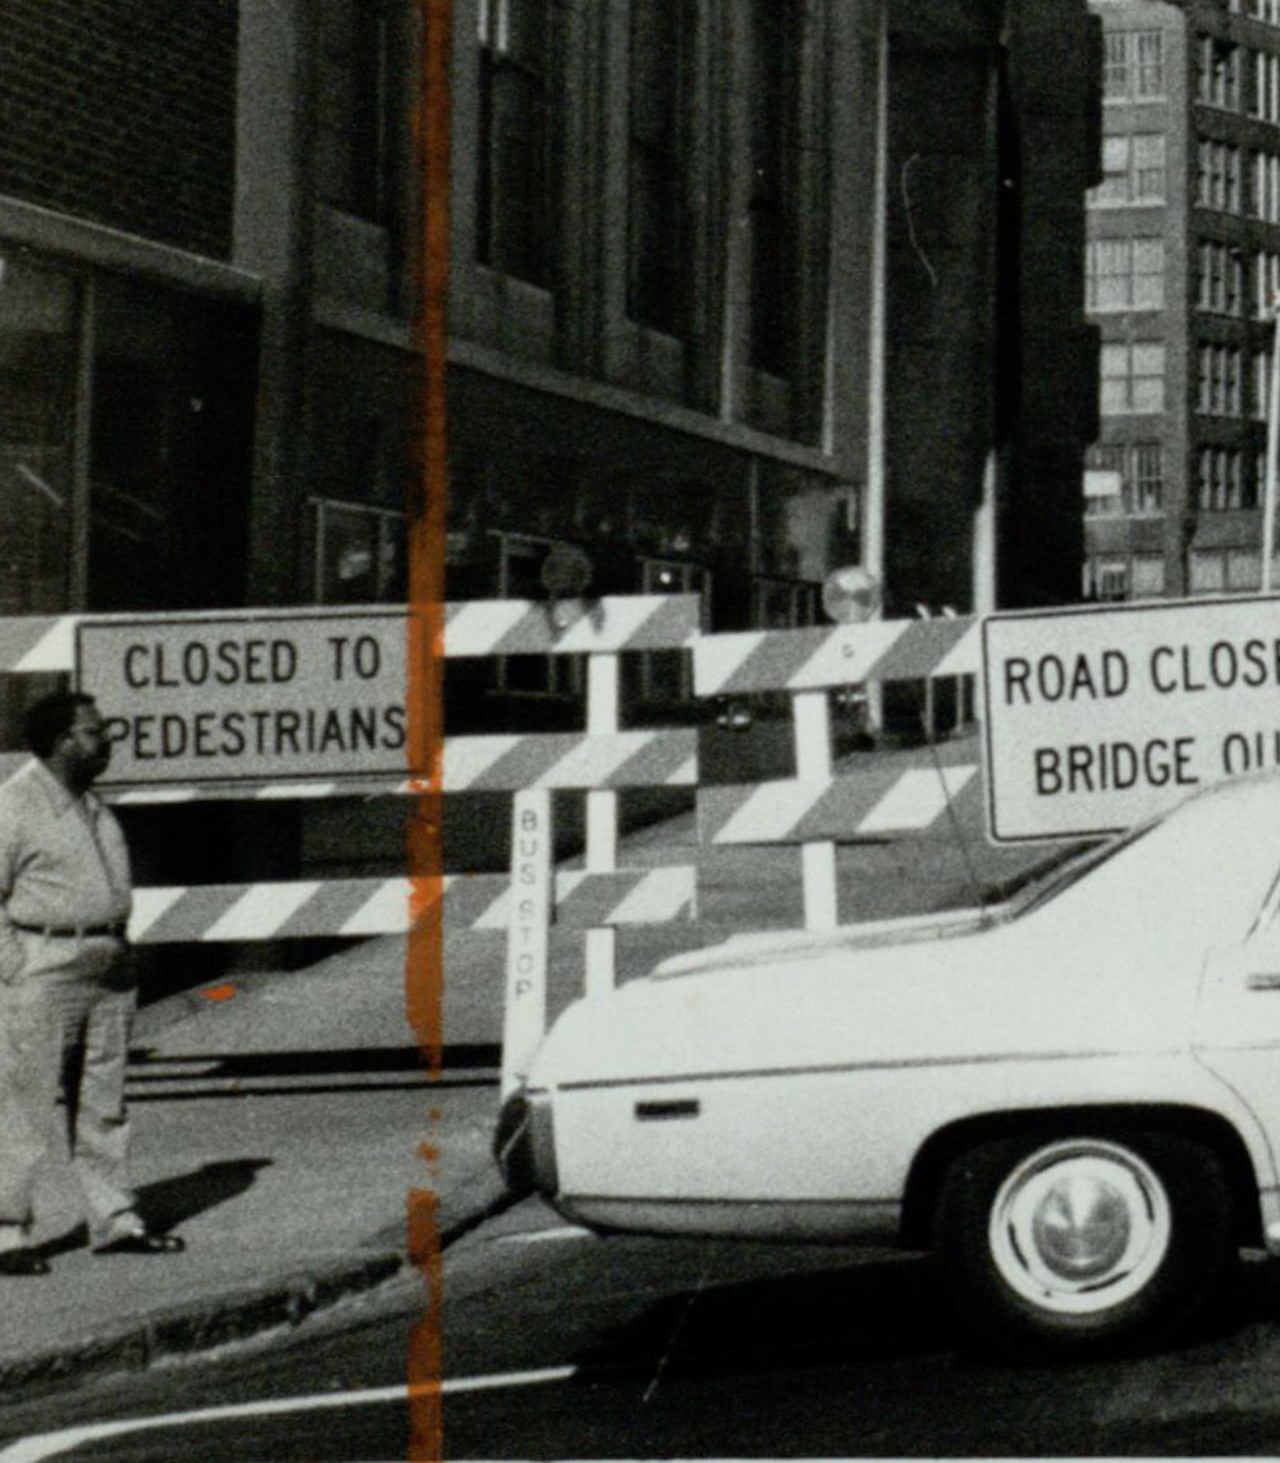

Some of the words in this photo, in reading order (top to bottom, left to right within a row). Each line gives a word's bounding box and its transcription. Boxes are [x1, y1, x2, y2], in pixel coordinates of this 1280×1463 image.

[123, 640, 297, 689] CLOSED
[328, 636, 382, 681] TO
[1003, 649, 1130, 706] ROAD
[1034, 736, 1200, 797] BRIDGE
[519, 808, 538, 886] BUS
[515, 899, 535, 996] STOP
